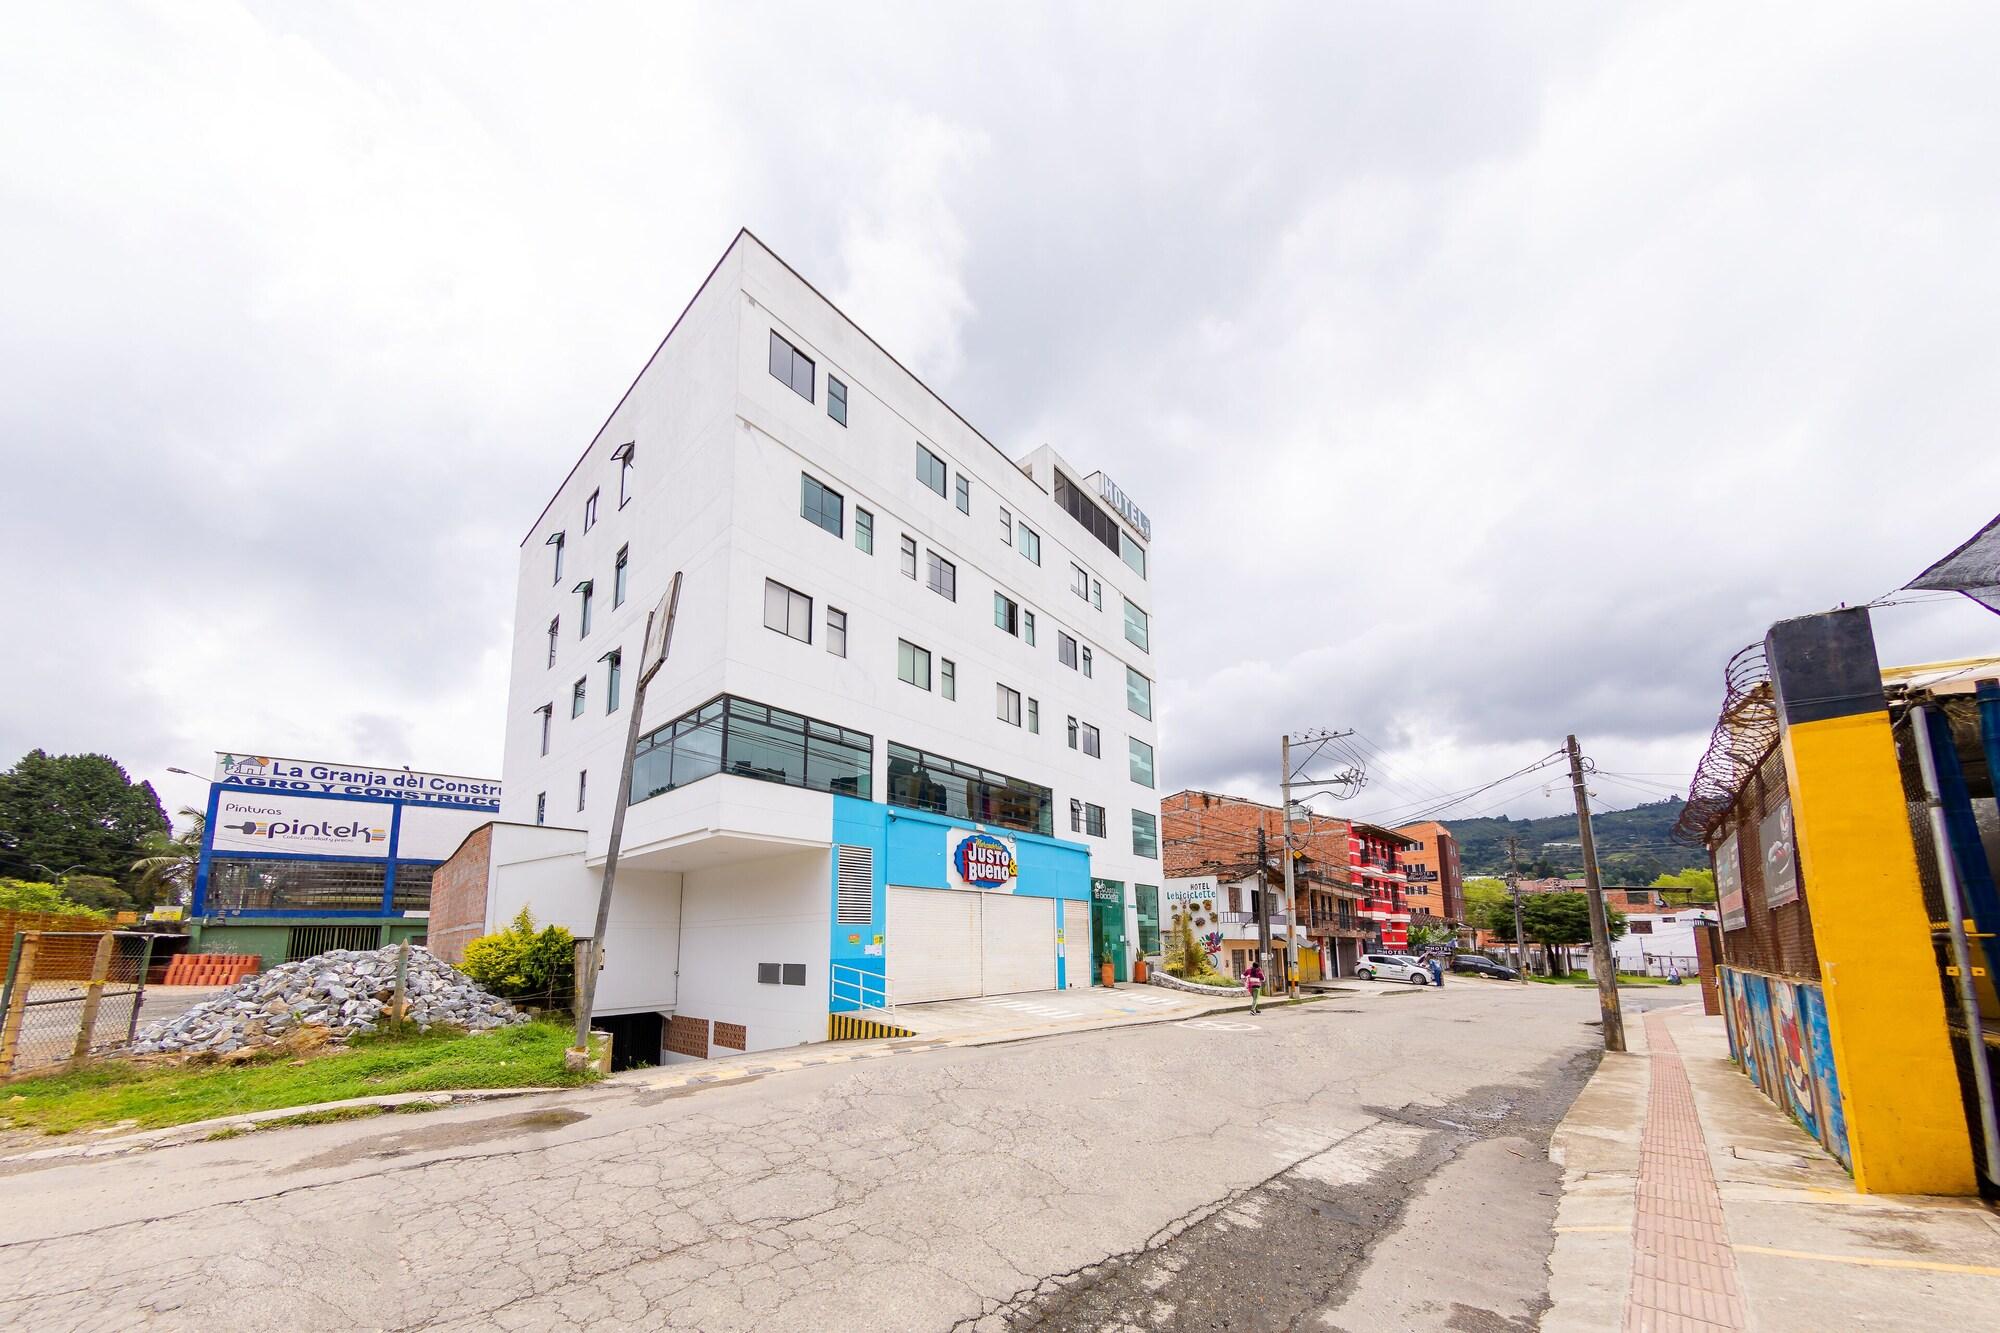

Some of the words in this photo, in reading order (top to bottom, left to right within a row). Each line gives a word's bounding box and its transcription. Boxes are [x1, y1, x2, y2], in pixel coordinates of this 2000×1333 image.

[1104, 475, 1145, 534] HOTEL
[222, 775, 310, 790] AGRO
[320, 784, 336, 793] Y
[272, 762, 304, 778] La
[310, 766, 387, 787] Granja
[393, 774, 424, 789] del
[429, 778, 502, 796] Constr
[225, 802, 283, 816] Pinturas
[267, 819, 371, 843] pintek
[1190, 882, 1210, 890] HOTEL
